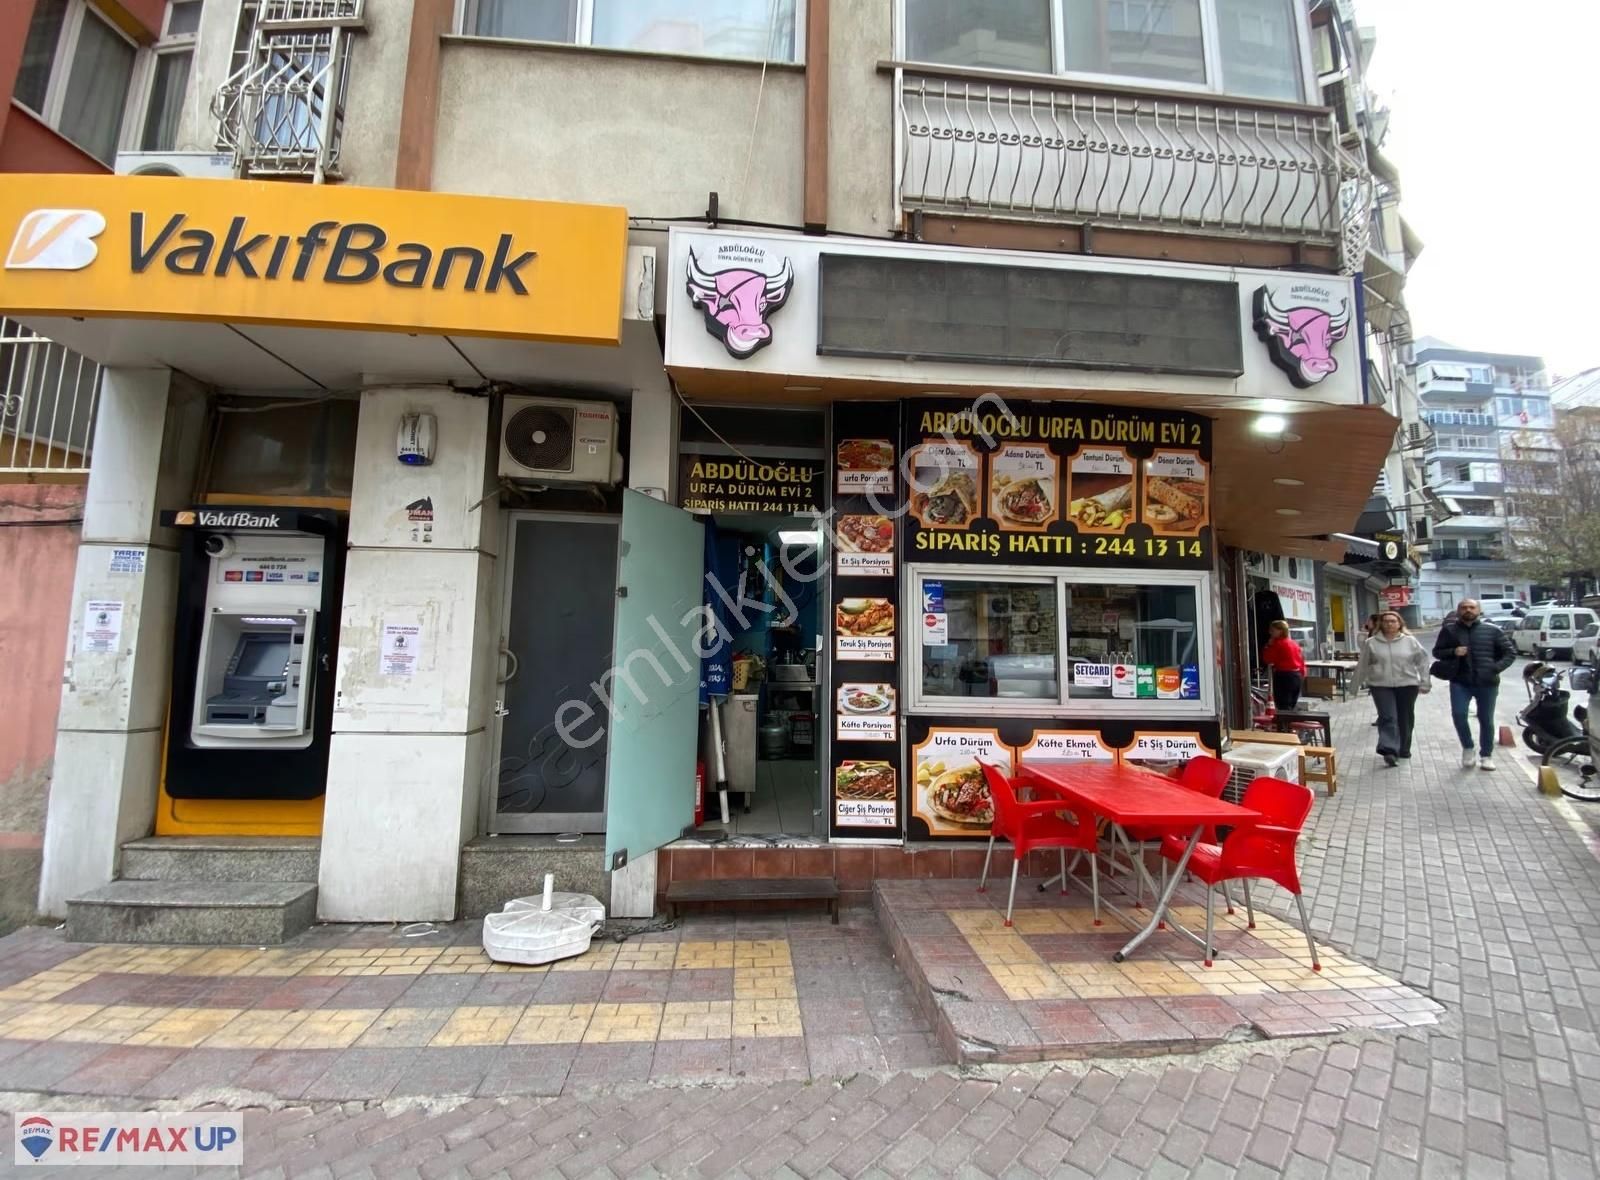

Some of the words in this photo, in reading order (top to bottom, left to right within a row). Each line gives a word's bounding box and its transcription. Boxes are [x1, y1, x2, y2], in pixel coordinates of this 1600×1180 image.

[130, 211, 538, 295] VakıfBank
[718, 243, 766, 257] ABDÜLOĞLU
[579, 412, 609, 420] TOSHIBA
[920, 407, 1032, 437] ABDÜLOĞLU
[1038, 416, 1082, 440] URFA
[1091, 413, 1155, 443] DÜRÜM
[1160, 418, 1186, 445] EVİ
[1191, 423, 1201, 445] 2
[1004, 449, 1024, 458] Adana
[1025, 450, 1046, 459] Dürüm
[1083, 452, 1104, 462] Tantuni
[1105, 453, 1125, 463] Dürüm
[957, 458, 967, 468] TL
[1035, 461, 1044, 471] TL
[1157, 455, 1175, 465] Döner
[1176, 456, 1195, 466] Dürüm
[690, 460, 813, 483] ABDÜLOĞLU
[1113, 464, 1121, 473] TL
[1186, 467, 1195, 477] TL
[844, 473, 859, 482] urfa
[689, 482, 724, 494] URFA
[728, 482, 777, 497] DÜRÜM
[781, 485, 801, 498] EVİ
[805, 487, 813, 498] 2
[684, 497, 725, 513] SİPARİŞ
[728, 500, 760, 512] HATTI
[762, 502, 783, 512] 244
[787, 502, 799, 513] 13
[198, 511, 280, 528] VakıfBank
[915, 527, 1001, 557] SİPARİŞ
[1009, 536, 1073, 554] HATTI
[1082, 541, 1087, 554] :
[1095, 538, 1136, 556] 244
[1144, 538, 1168, 557] 13
[1176, 540, 1203, 558] 14
[841, 557, 849, 565] Et
[850, 557, 860, 567] Şiş
[862, 557, 890, 567] Porsiyon
[840, 639, 857, 648] Tavuk
[858, 639, 866, 649] Şiş
[867, 639, 892, 650] Porsiyon
[1075, 664, 1110, 676] SETCARD
[841, 720, 861, 729] Köfte
[862, 720, 892, 731] Porsiyon
[935, 736, 957, 746] Urfa
[960, 737, 993, 747] Dürüm
[1037, 738, 1063, 748] Köfte
[1066, 738, 1097, 749] Ekmek
[1138, 739, 1147, 748] Et
[1150, 739, 1163, 751] Şiş
[1166, 739, 1197, 749] Dürüm
[977, 748, 988, 756] TL
[1081, 749, 1092, 758] TL
[1180, 751, 1191, 759] TL
[838, 803, 856, 816] Ciğer
[857, 804, 866, 816] Şiş
[867, 804, 894, 816] Porsiyon
[883, 817, 893, 825] TL
